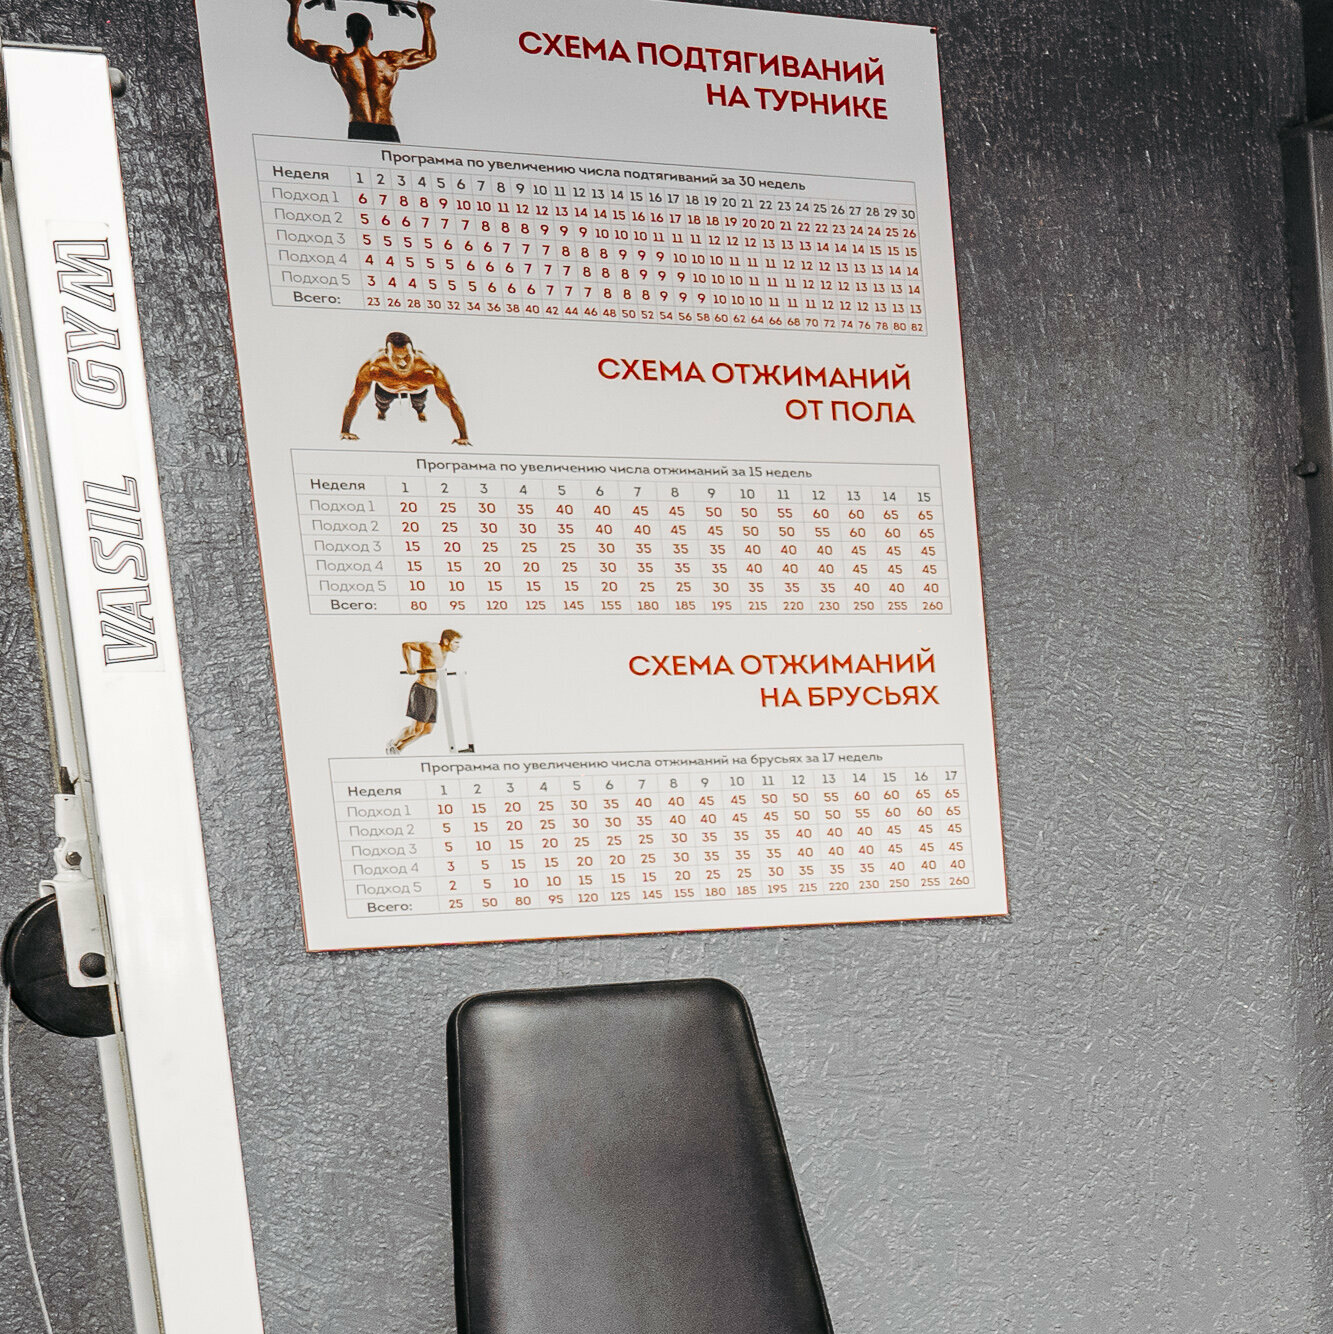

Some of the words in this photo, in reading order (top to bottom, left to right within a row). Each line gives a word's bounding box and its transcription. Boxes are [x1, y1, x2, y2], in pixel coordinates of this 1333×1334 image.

[519, 31, 631, 63] СХЕМА
[637, 42, 884, 85] ПОДТЯГИВАНИЙ
[706, 83, 750, 108] НА
[754, 87, 888, 120] ТУРНИКЕ
[273, 166, 329, 180] Неделя
[381, 150, 463, 167] Программа
[467, 159, 484, 168] по
[487, 160, 576, 174] увеличению
[579, 167, 620, 177] числа
[624, 170, 718, 184] подтягиваний
[721, 177, 736, 185] за
[739, 176, 755, 187] 30
[759, 180, 806, 190] недель
[272, 187, 329, 204] Подход
[332, 191, 339, 203] 1
[358, 193, 367, 204] 6
[379, 194, 387, 205] 7
[400, 196, 408, 207] 8
[420, 197, 428, 208] 8
[439, 198, 448, 209] 9
[456, 200, 471, 210] 10
[477, 201, 491, 212] 10
[498, 202, 510, 213] 11
[516, 204, 529, 214] 12
[536, 205, 549, 216] 12
[555, 206, 568, 217] 13
[574, 207, 588, 217] 14
[594, 209, 607, 219] 14
[613, 210, 626, 220] 15
[632, 211, 645, 222] 16
[650, 212, 664, 223] 16
[669, 214, 681, 223] 17
[688, 214, 701, 225] 18
[706, 216, 719, 226] 18
[725, 217, 737, 226] 19
[742, 218, 757, 228] 20
[760, 220, 775, 230] 20
[780, 221, 792, 231] 21
[797, 222, 810, 232] 22
[815, 223, 828, 233] 22
[832, 224, 846, 234] 23
[850, 225, 864, 235] 24
[868, 226, 881, 236] 24
[885, 227, 899, 237] 25
[903, 229, 916, 238] 26
[274, 208, 332, 224] Подход
[334, 211, 342, 223] 2
[276, 229, 334, 245] Подход
[337, 232, 346, 244] 3
[293, 291, 341, 304] Всего:
[53, 237, 127, 410] GYM
[598, 358, 706, 383] СХЕМА
[712, 362, 910, 390] ОТЖИМАНИЙ
[786, 399, 823, 420] ОТ
[831, 400, 915, 423] ПОЛА
[416, 459, 496, 473] Программа
[520, 464, 606, 475] увеличению
[609, 466, 650, 474] числа
[653, 466, 728, 476] отжиманий
[749, 466, 763, 477] 15
[766, 470, 812, 478] недель
[310, 479, 365, 491] Неделя
[309, 499, 365, 513] Подход
[368, 500, 375, 512] 1
[400, 502, 417, 513] 20
[440, 502, 456, 513] 25
[478, 502, 496, 513] 30
[517, 504, 534, 515] 35
[556, 504, 573, 515] 40
[594, 505, 611, 515] 40
[632, 506, 648, 516] 45
[669, 506, 685, 516] 45
[705, 507, 722, 517] 50
[741, 507, 757, 518] 50
[777, 508, 793, 518] 55
[813, 509, 829, 519] 60
[848, 509, 864, 519] 60
[883, 510, 899, 520] 65
[918, 510, 933, 520] 65
[312, 519, 368, 533] Подход
[371, 520, 379, 532] 2
[314, 540, 370, 553] Подход
[373, 540, 382, 552] 3
[82, 475, 159, 666] VASIL
[316, 559, 372, 572] Подход
[375, 560, 383, 570] 4
[319, 580, 375, 593] Подход
[377, 580, 387, 592] 5
[331, 599, 377, 610] Всего:
[629, 655, 734, 676] СХЕМА
[741, 647, 935, 675] ОТЖИМАНИЙ
[761, 687, 801, 707] НА
[808, 685, 939, 707] БРУСЬЯХ
[421, 762, 500, 776] Программа
[523, 761, 608, 773] увеличению
[654, 755, 729, 767] отжиманий
[750, 754, 802, 767] брусьях
[806, 755, 819, 763] за
[822, 752, 835, 762] 17
[838, 754, 883, 762] недель
[348, 786, 402, 797] Неделя
[347, 806, 402, 818] Подход
[404, 805, 411, 816] 1
[349, 825, 404, 837] Подход
[406, 824, 415, 835] 2
[351, 845, 406, 857] Подход
[409, 843, 417, 854] 3
[367, 902, 412, 913] Всего:
[449, 899, 463, 909] 25
[482, 898, 498, 908] 50
[515, 896, 531, 906] 80
[548, 894, 563, 904] 95
[578, 893, 598, 903] 120
[611, 891, 630, 901] 125
[642, 890, 662, 900] 145
[674, 888, 694, 898] 155
[705, 887, 726, 897] 180
[737, 886, 757, 896] 185
[768, 884, 787, 894] 195
[798, 883, 818, 892] 215
[829, 881, 849, 891] 220
[859, 880, 879, 889] 230
[889, 878, 910, 888] 250
[921, 877, 940, 887] 255
[949, 876, 970, 886] 260
